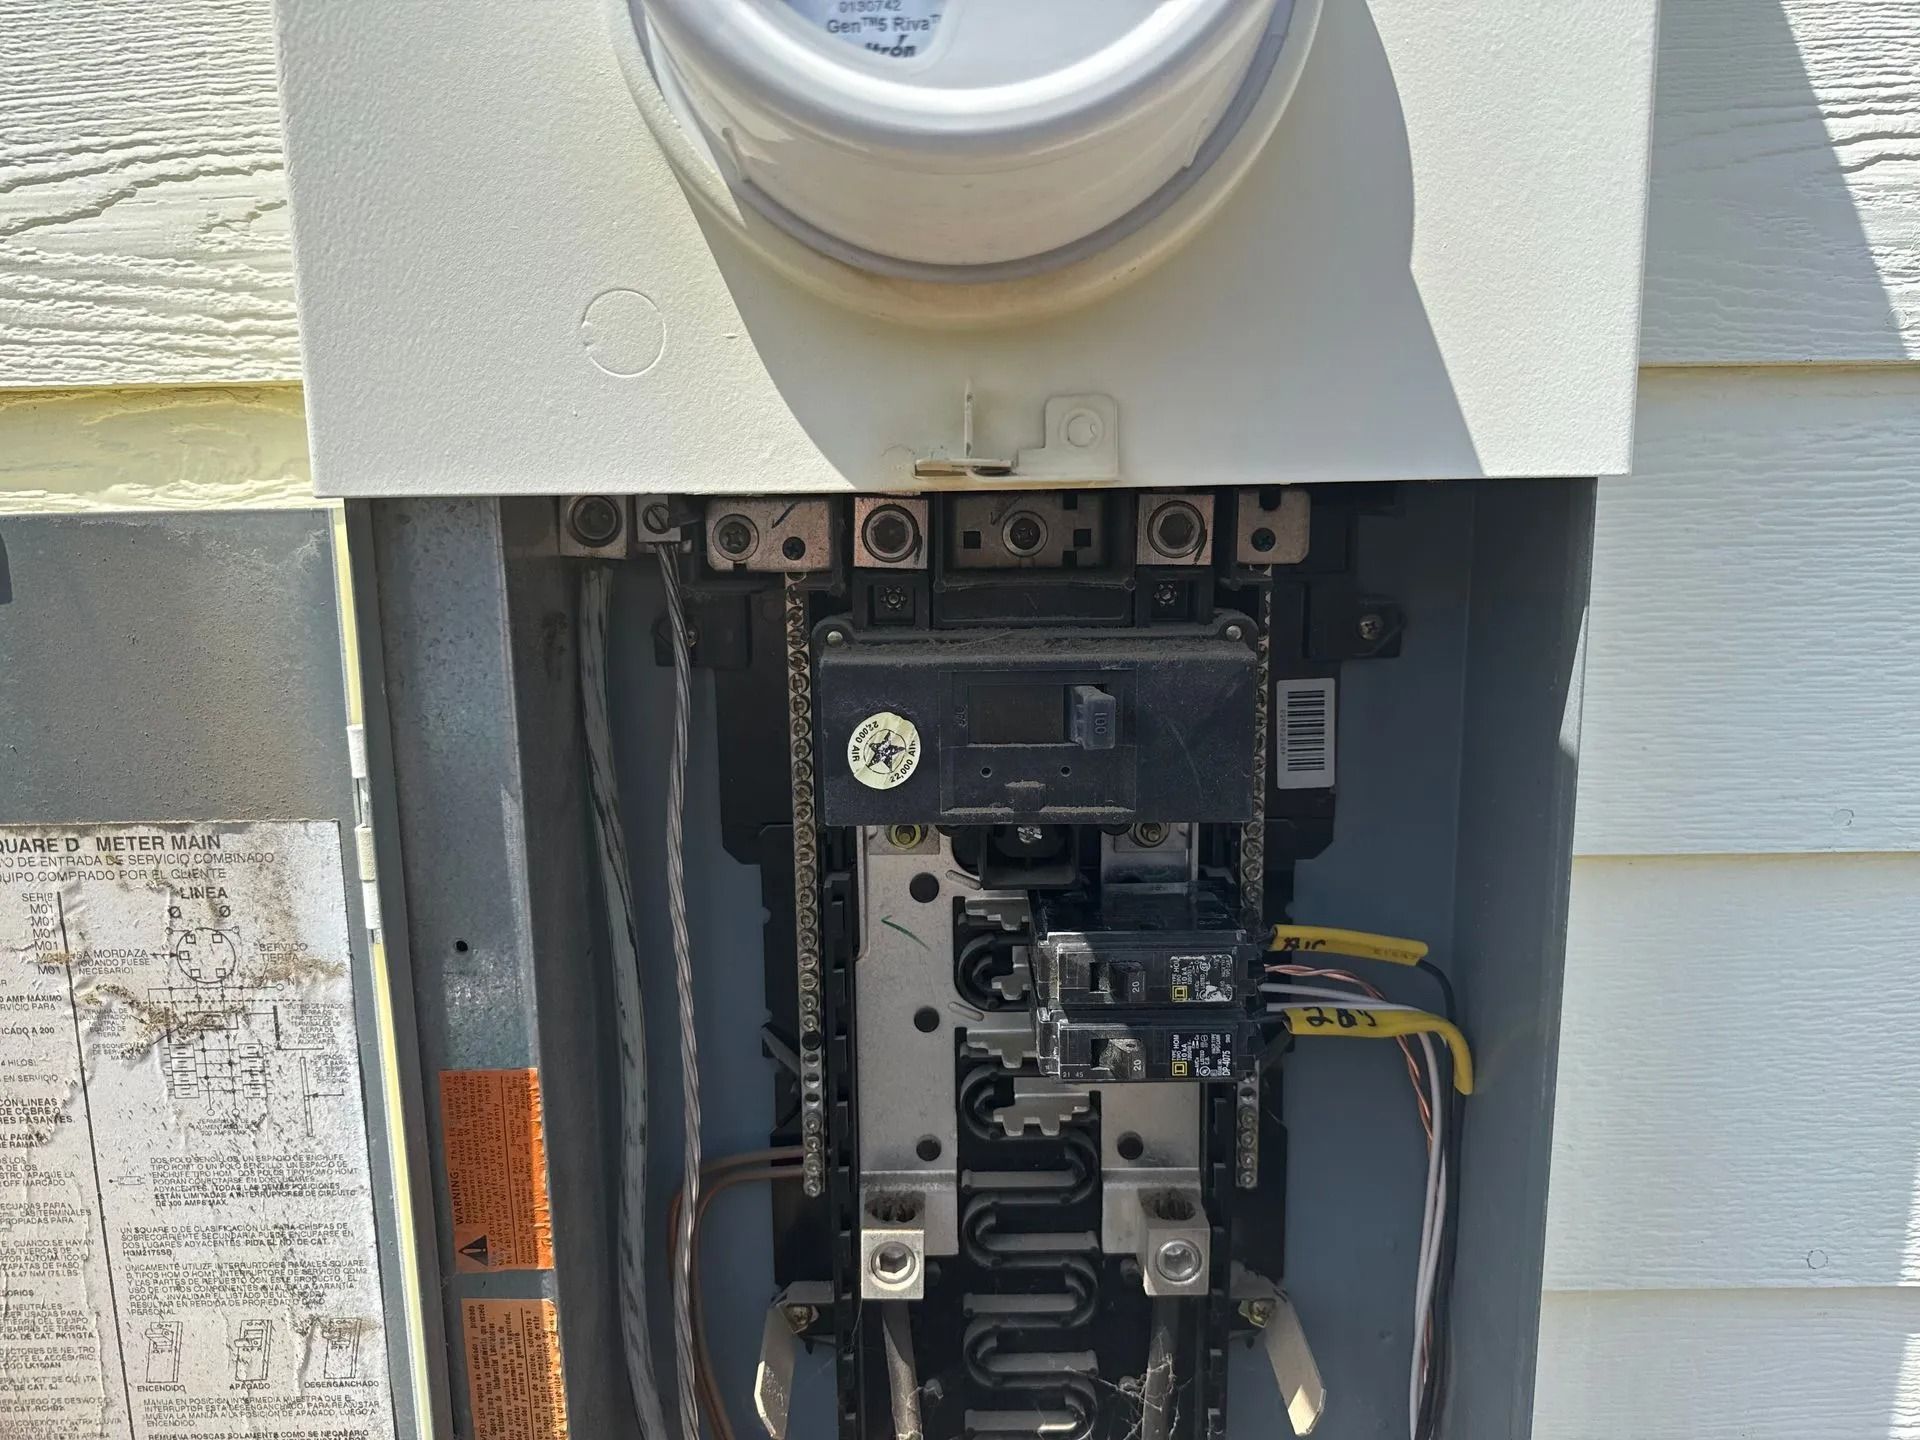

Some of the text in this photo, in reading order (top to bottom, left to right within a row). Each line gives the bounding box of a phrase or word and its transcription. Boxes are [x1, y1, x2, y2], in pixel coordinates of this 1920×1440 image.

[1094, 712, 1108, 735] 100
[852, 721, 879, 762] 22,000 AIR
[890, 759, 914, 782] 22,000
[66, 837, 80, 852] D
[96, 836, 165, 852] METER
[171, 835, 221, 850] MAIN
[18, 857, 36, 867] DE
[40, 856, 102, 867] ENTRADA
[128, 853, 190, 866] SERVICIO
[194, 852, 274, 864] COMBINADO
[0, 868, 226, 883] UIPO COMPRADO POR EL CLIENTE
[33, 929, 56, 938] M01
[34, 941, 58, 950] M01
[94, 949, 148, 959] MORDAZA
[78, 958, 150, 968] (CUANDO FUESE
[79, 967, 135, 976] NECESARIO)
[1131, 981, 1140, 993] 20
[32, 1002, 56, 1010] PARA
[1181, 1052, 1188, 1061] 10
[1133, 1059, 1142, 1072] 20
[1222, 1050, 1231, 1076] DP-4075
[15, 1107, 51, 1115] COBRE
[27, 1171, 63, 1179] APAGUE
[23, 1179, 65, 1187] MARCADO
[451, 1168, 463, 1225] WARNING:
[39, 1209, 92, 1217] TERMINALES
[51, 1216, 74, 1224] PARA
[57, 1261, 79, 1269] PASO
[137, 1380, 380, 1392] ENCENDIDO APAGADO DESENGANCHADO
